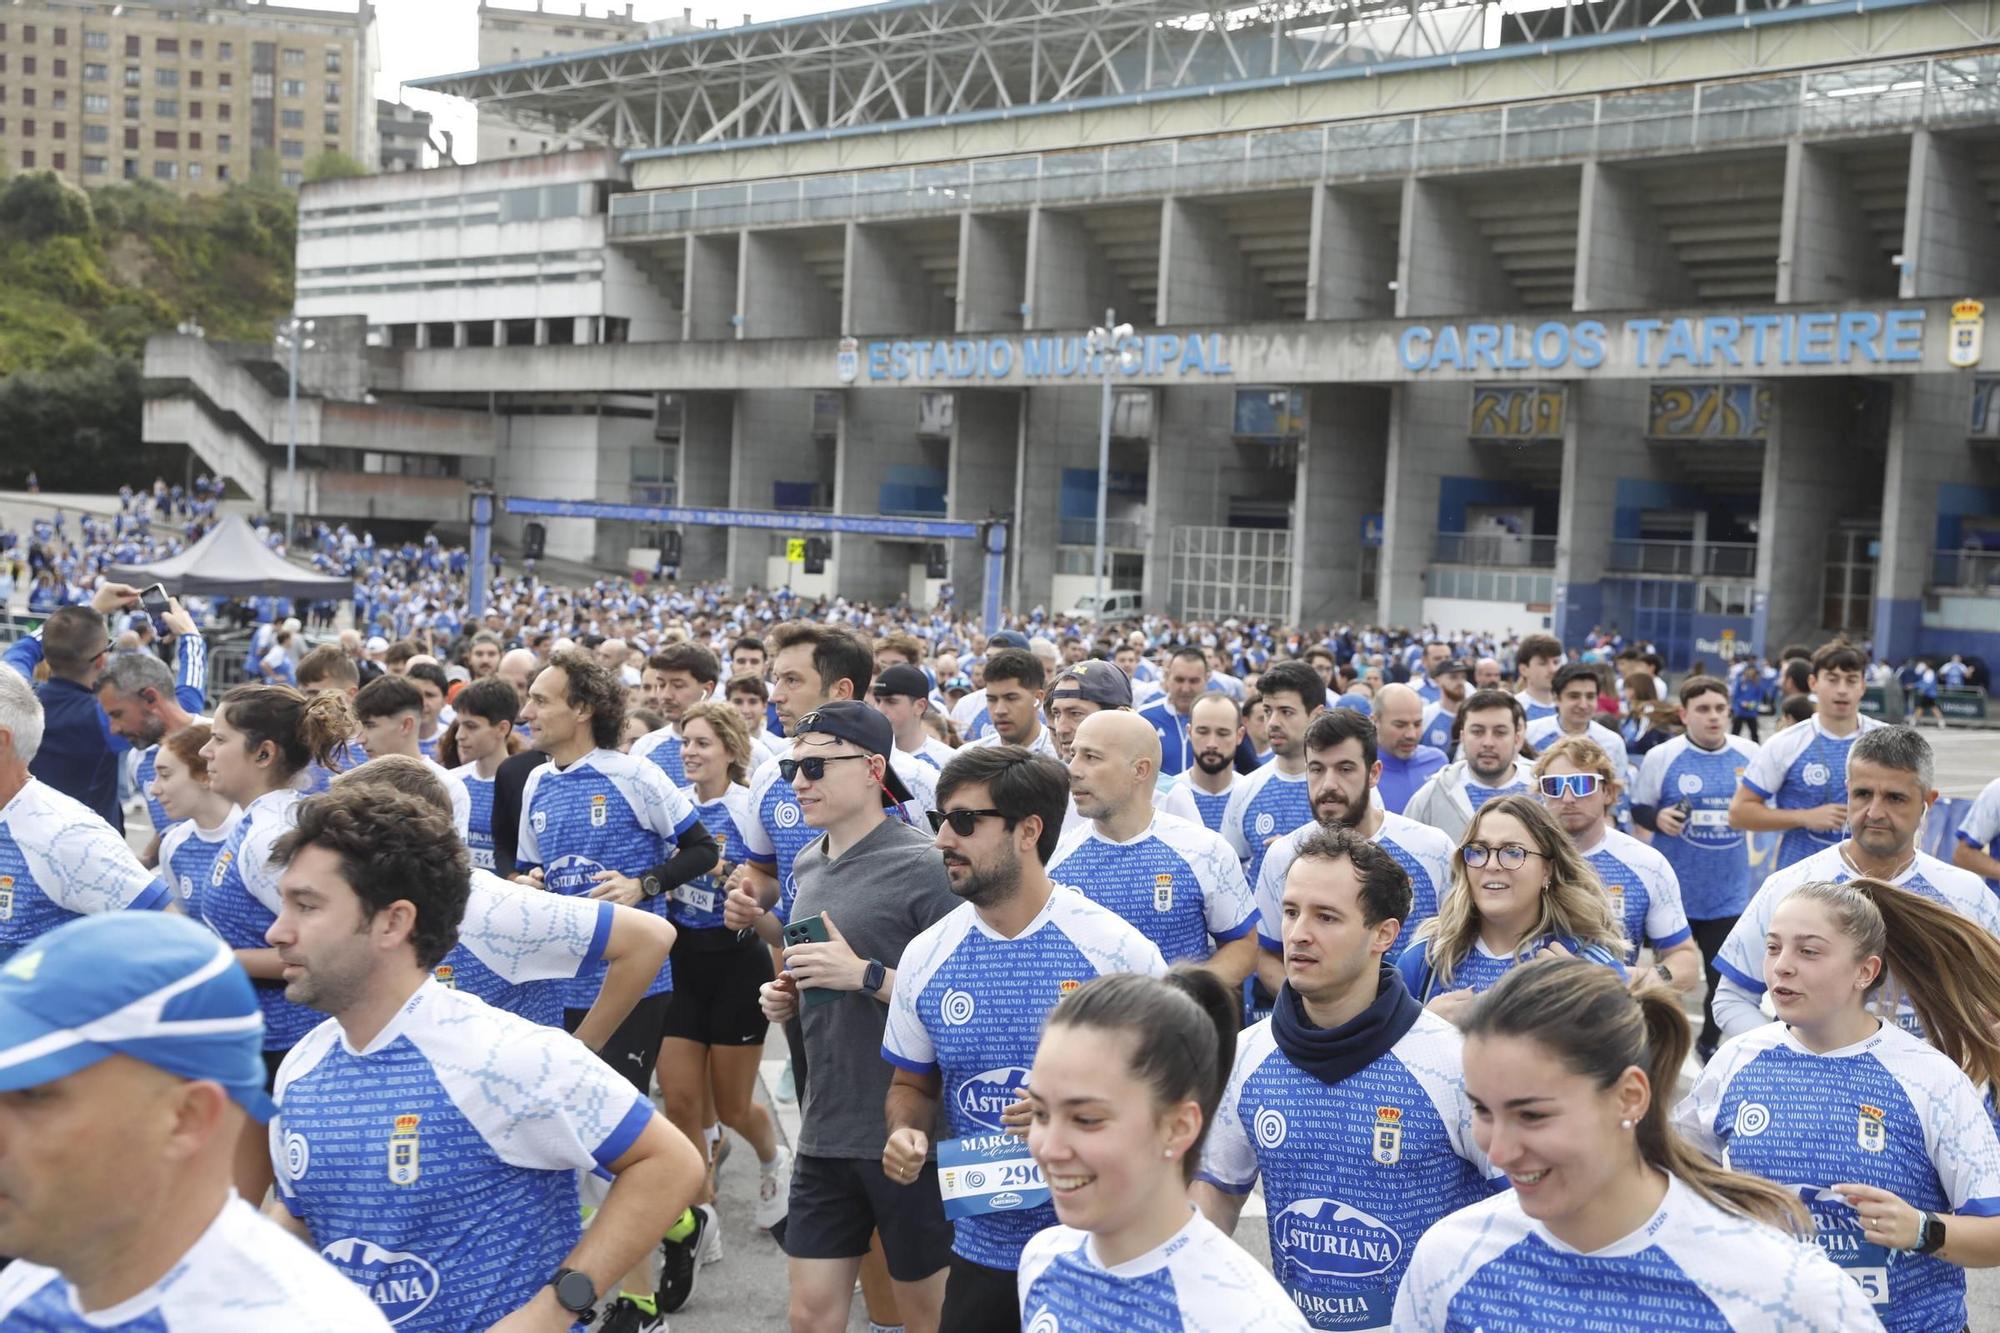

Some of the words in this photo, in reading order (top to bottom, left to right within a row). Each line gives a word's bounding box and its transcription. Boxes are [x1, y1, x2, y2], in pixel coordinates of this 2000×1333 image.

[1400, 320, 1607, 372] CARLOS
[1627, 309, 1926, 367] TARTIERE
[867, 340, 1013, 380] ESTADIO
[1022, 333, 1233, 377] MUNCIPAL
[981, 1086, 1016, 1095] CENTRA
[1326, 1088, 1366, 1101] ADRIANO
[1284, 1108, 1343, 1122] VILLAVICIOSA
[1291, 1218, 1332, 1232] CENTRAL
[1336, 1225, 1387, 1240] LECHERA
[1293, 1288, 1370, 1314] MARCHA
